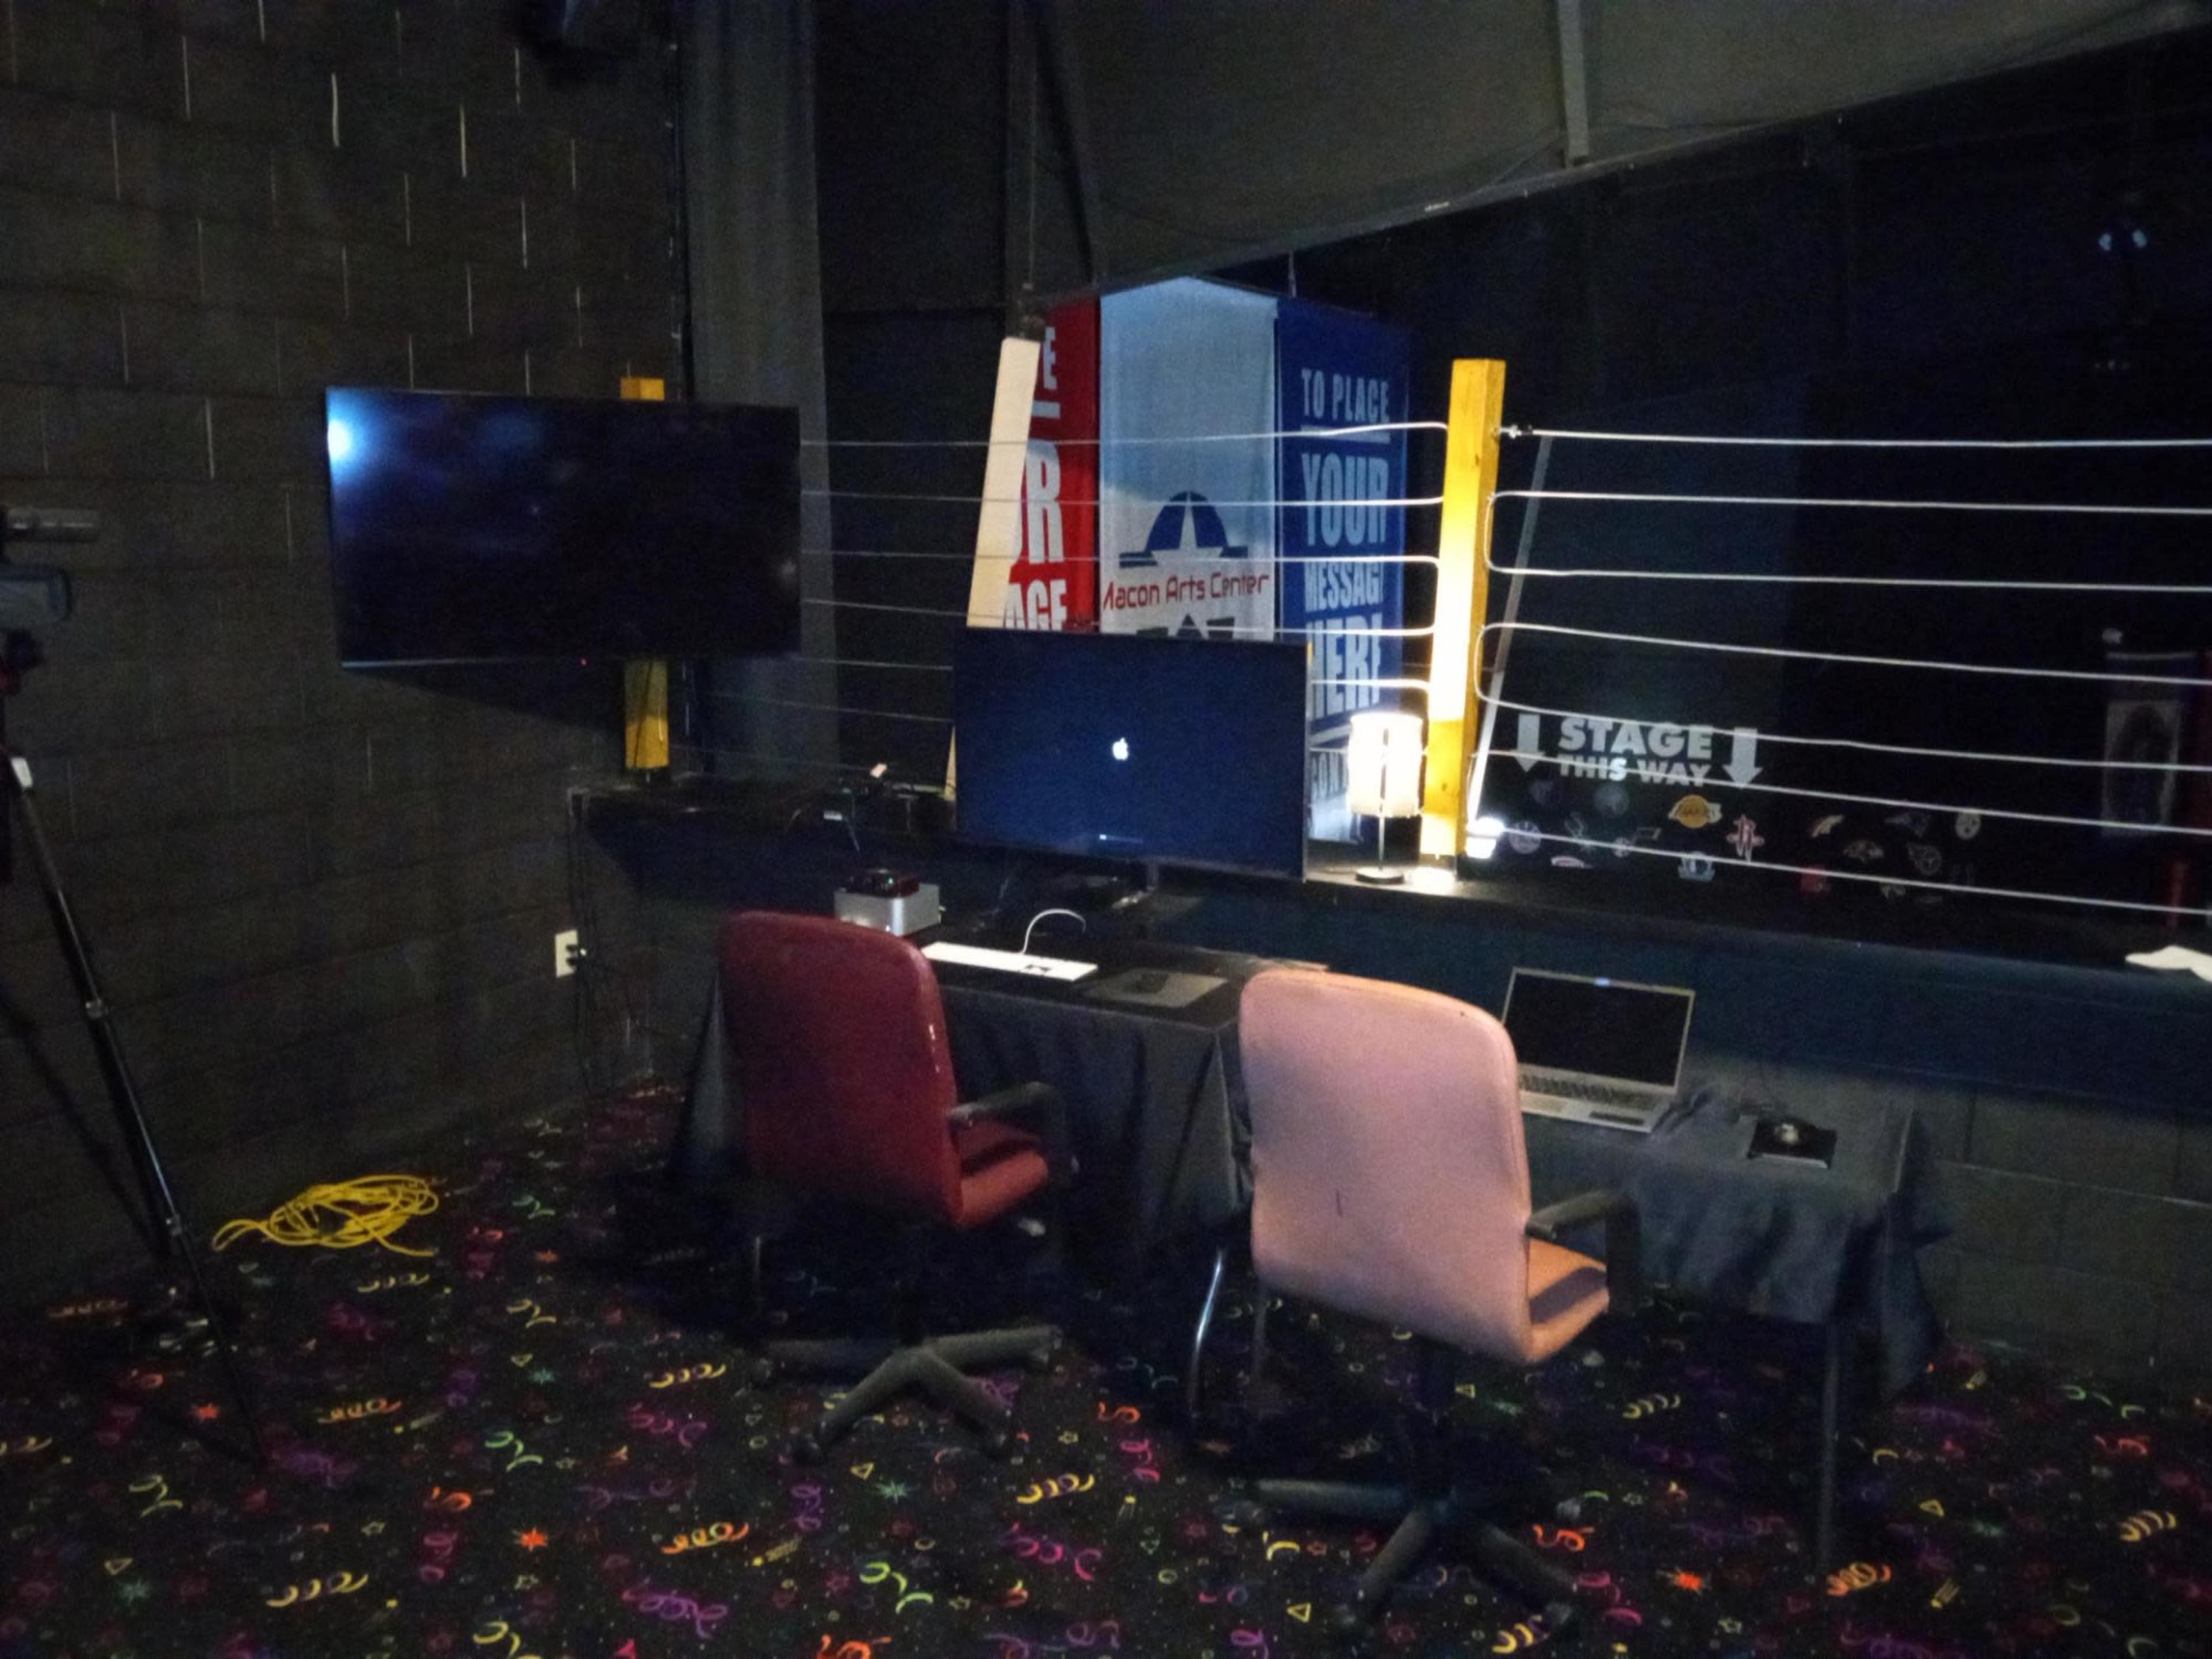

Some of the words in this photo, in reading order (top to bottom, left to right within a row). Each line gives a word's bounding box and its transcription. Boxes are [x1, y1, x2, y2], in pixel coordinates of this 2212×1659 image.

[1301, 368, 1324, 419] TO
[1332, 373, 1389, 423] PLACE
[1301, 452, 1388, 547] YOUR
[1165, 575, 1205, 603] Arts
[1210, 571, 1270, 598] Center
[1558, 715, 1714, 760] STAGE
[1556, 753, 1627, 782] THIS
[1637, 759, 1711, 787] WAY
